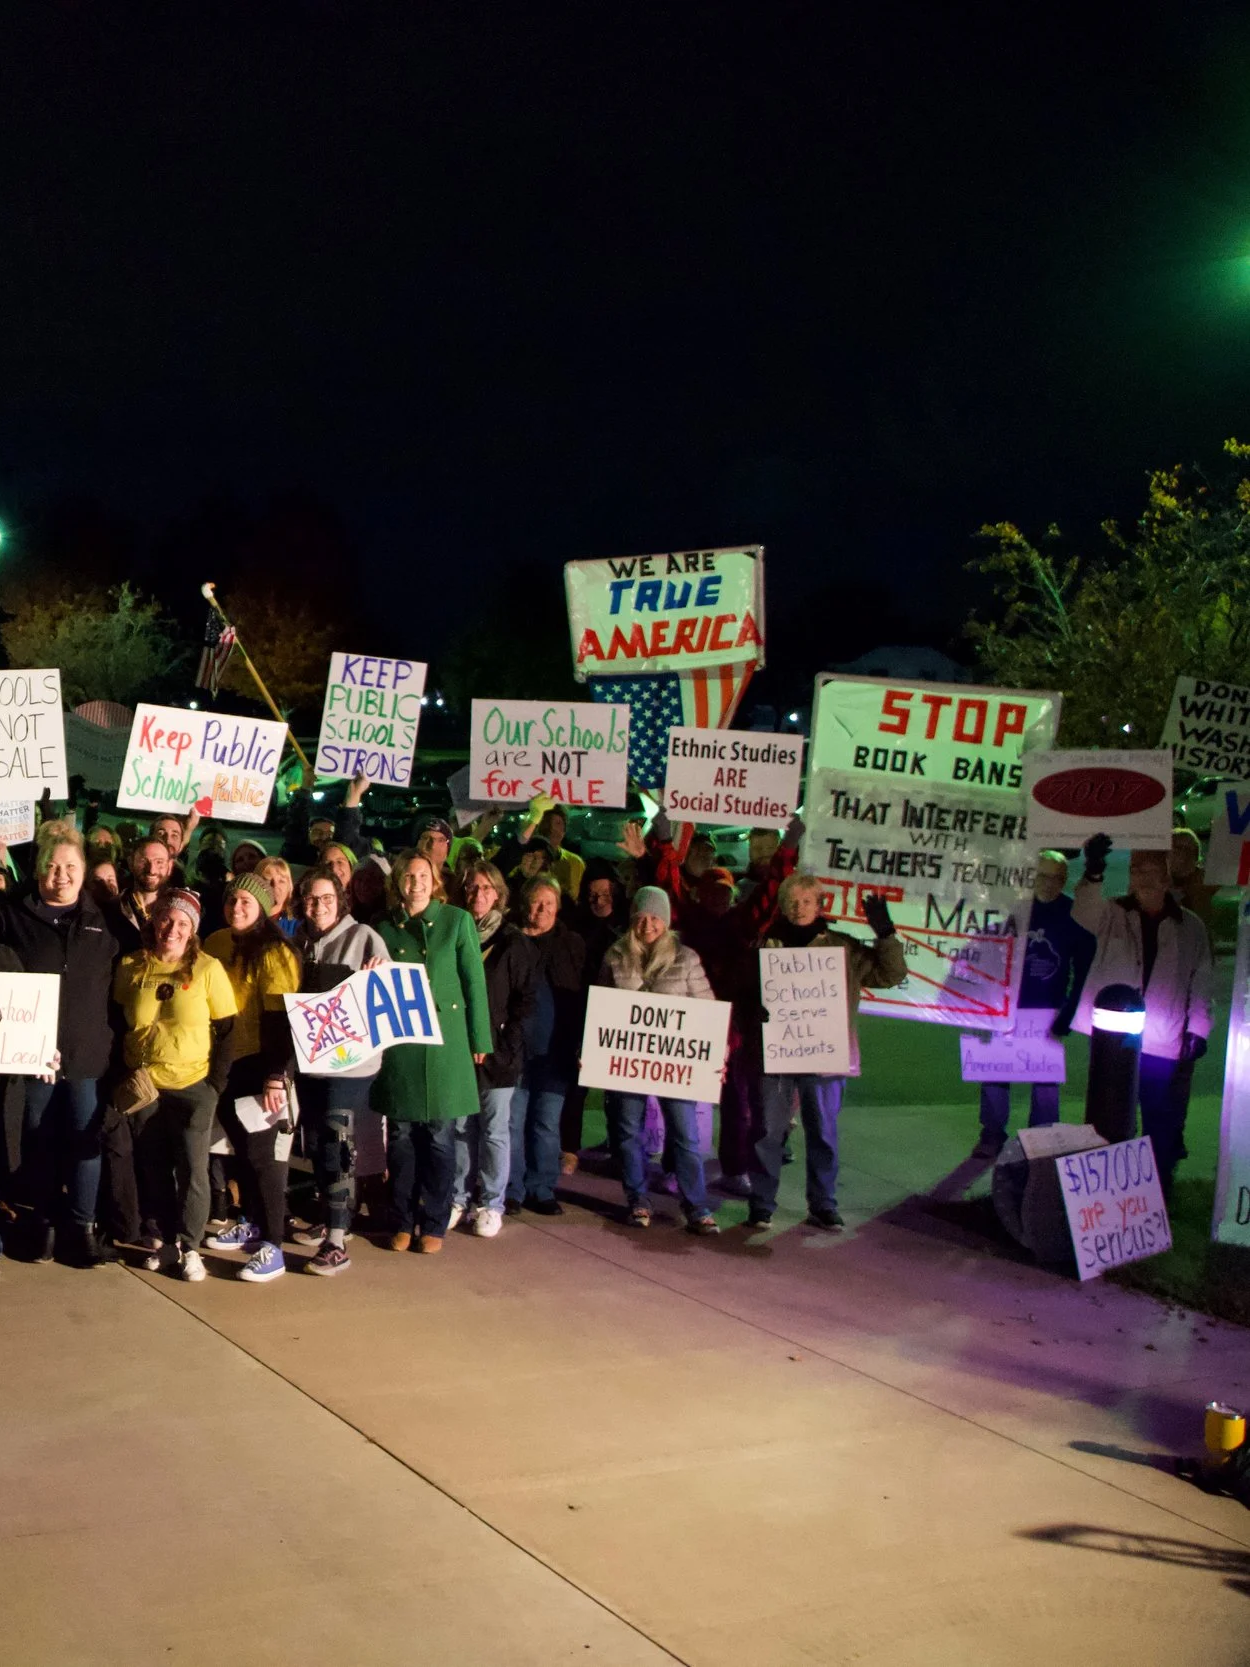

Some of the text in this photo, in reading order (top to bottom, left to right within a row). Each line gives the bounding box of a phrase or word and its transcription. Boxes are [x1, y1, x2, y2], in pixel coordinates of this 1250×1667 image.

[608, 552, 715, 579] WE ARE
[609, 575, 722, 615] TRUE
[577, 611, 763, 663] AMERICA
[341, 655, 413, 689] KEEP
[327, 684, 422, 723] PUBLIC
[878, 689, 1027, 747] STOP
[139, 716, 192, 766] Keep
[200, 720, 277, 776] Public
[324, 714, 414, 750] SCHOOLS
[483, 706, 627, 753] Our Schools
[317, 745, 412, 784] STRONG
[485, 750, 589, 778] are NOT
[672, 737, 797, 765] Ethnic Studies
[853, 745, 1023, 788] BOOK BANS
[126, 755, 265, 808] Schools Public
[481, 770, 605, 805] for SALE
[713, 767, 747, 788] ARE
[669, 790, 719, 814] Social
[830, 789, 891, 825] THAT
[909, 831, 968, 851] WITH
[825, 838, 1036, 889] TEACHERS TEACHING
[925, 893, 1019, 938] MAGA
[768, 953, 837, 975] Public
[764, 979, 839, 1004] Schools
[303, 997, 349, 1031] FOR
[630, 1004, 686, 1031] DON'T
[0, 1032, 46, 1067] Local
[307, 1018, 357, 1052] SALE
[598, 1027, 711, 1062] WHITEWASH
[782, 1024, 815, 1041] ALL
[767, 1042, 836, 1060] Students
[609, 1056, 693, 1087] HISTORY!
[1079, 1197, 1148, 1232] are you
